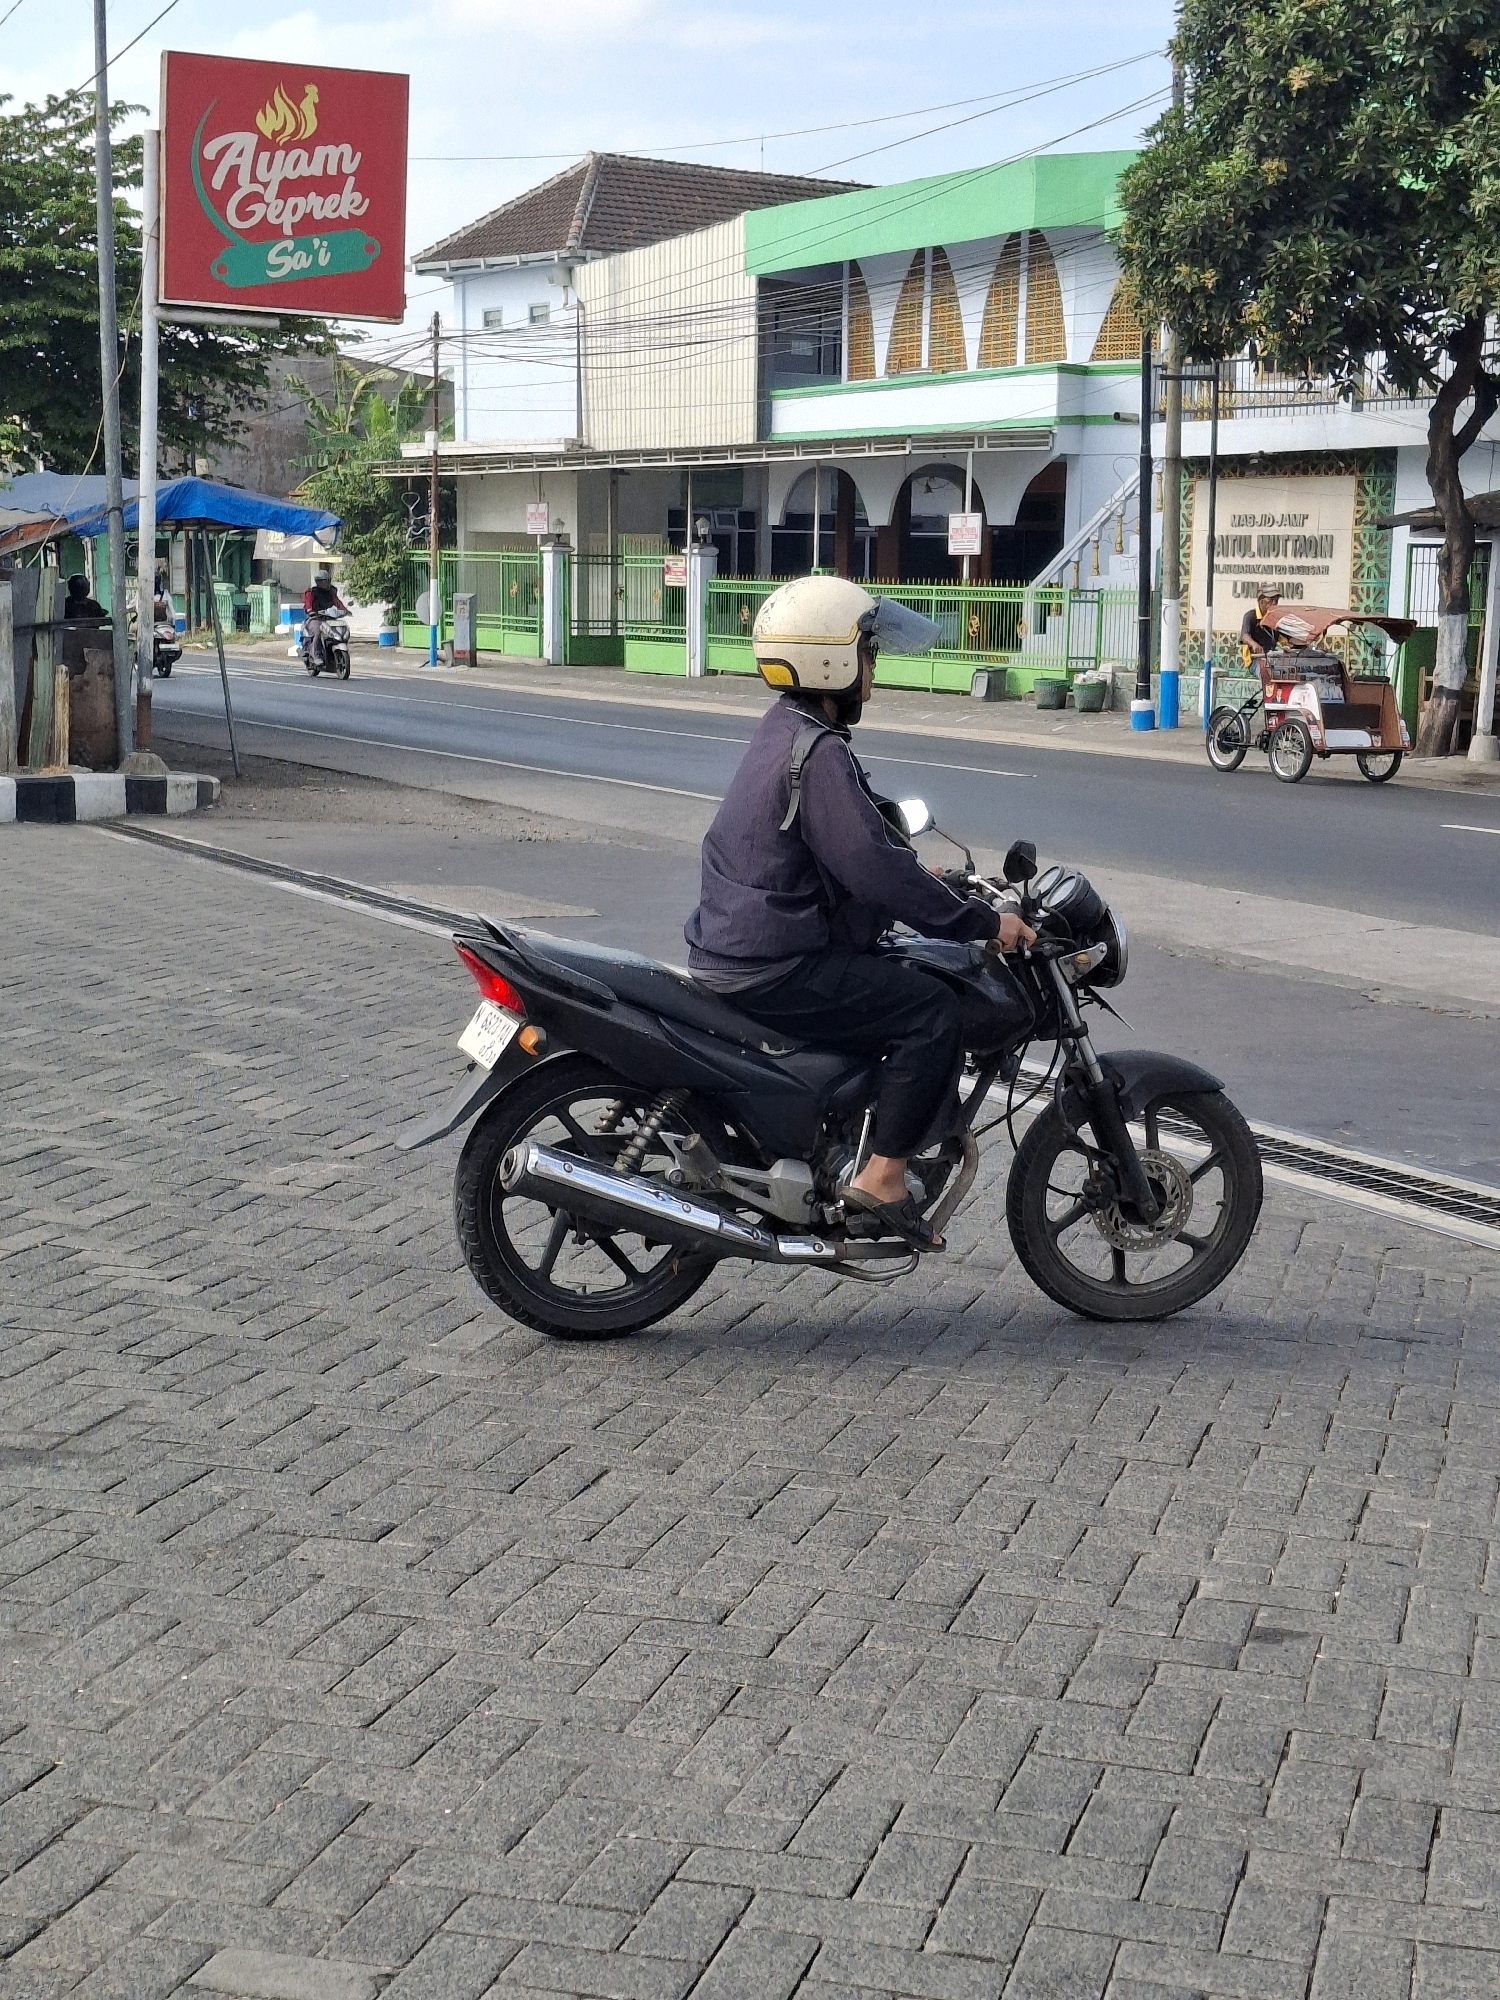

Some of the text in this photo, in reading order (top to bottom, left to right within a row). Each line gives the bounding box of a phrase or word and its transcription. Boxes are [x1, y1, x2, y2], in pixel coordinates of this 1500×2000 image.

[203, 132, 362, 203] Ayam
[226, 176, 370, 236] Geprek
[266, 237, 331, 278] Sa'i
[1206, 534, 1334, 559] AITUL MUTTAQIN
[1232, 581, 1304, 600] LUMANG
